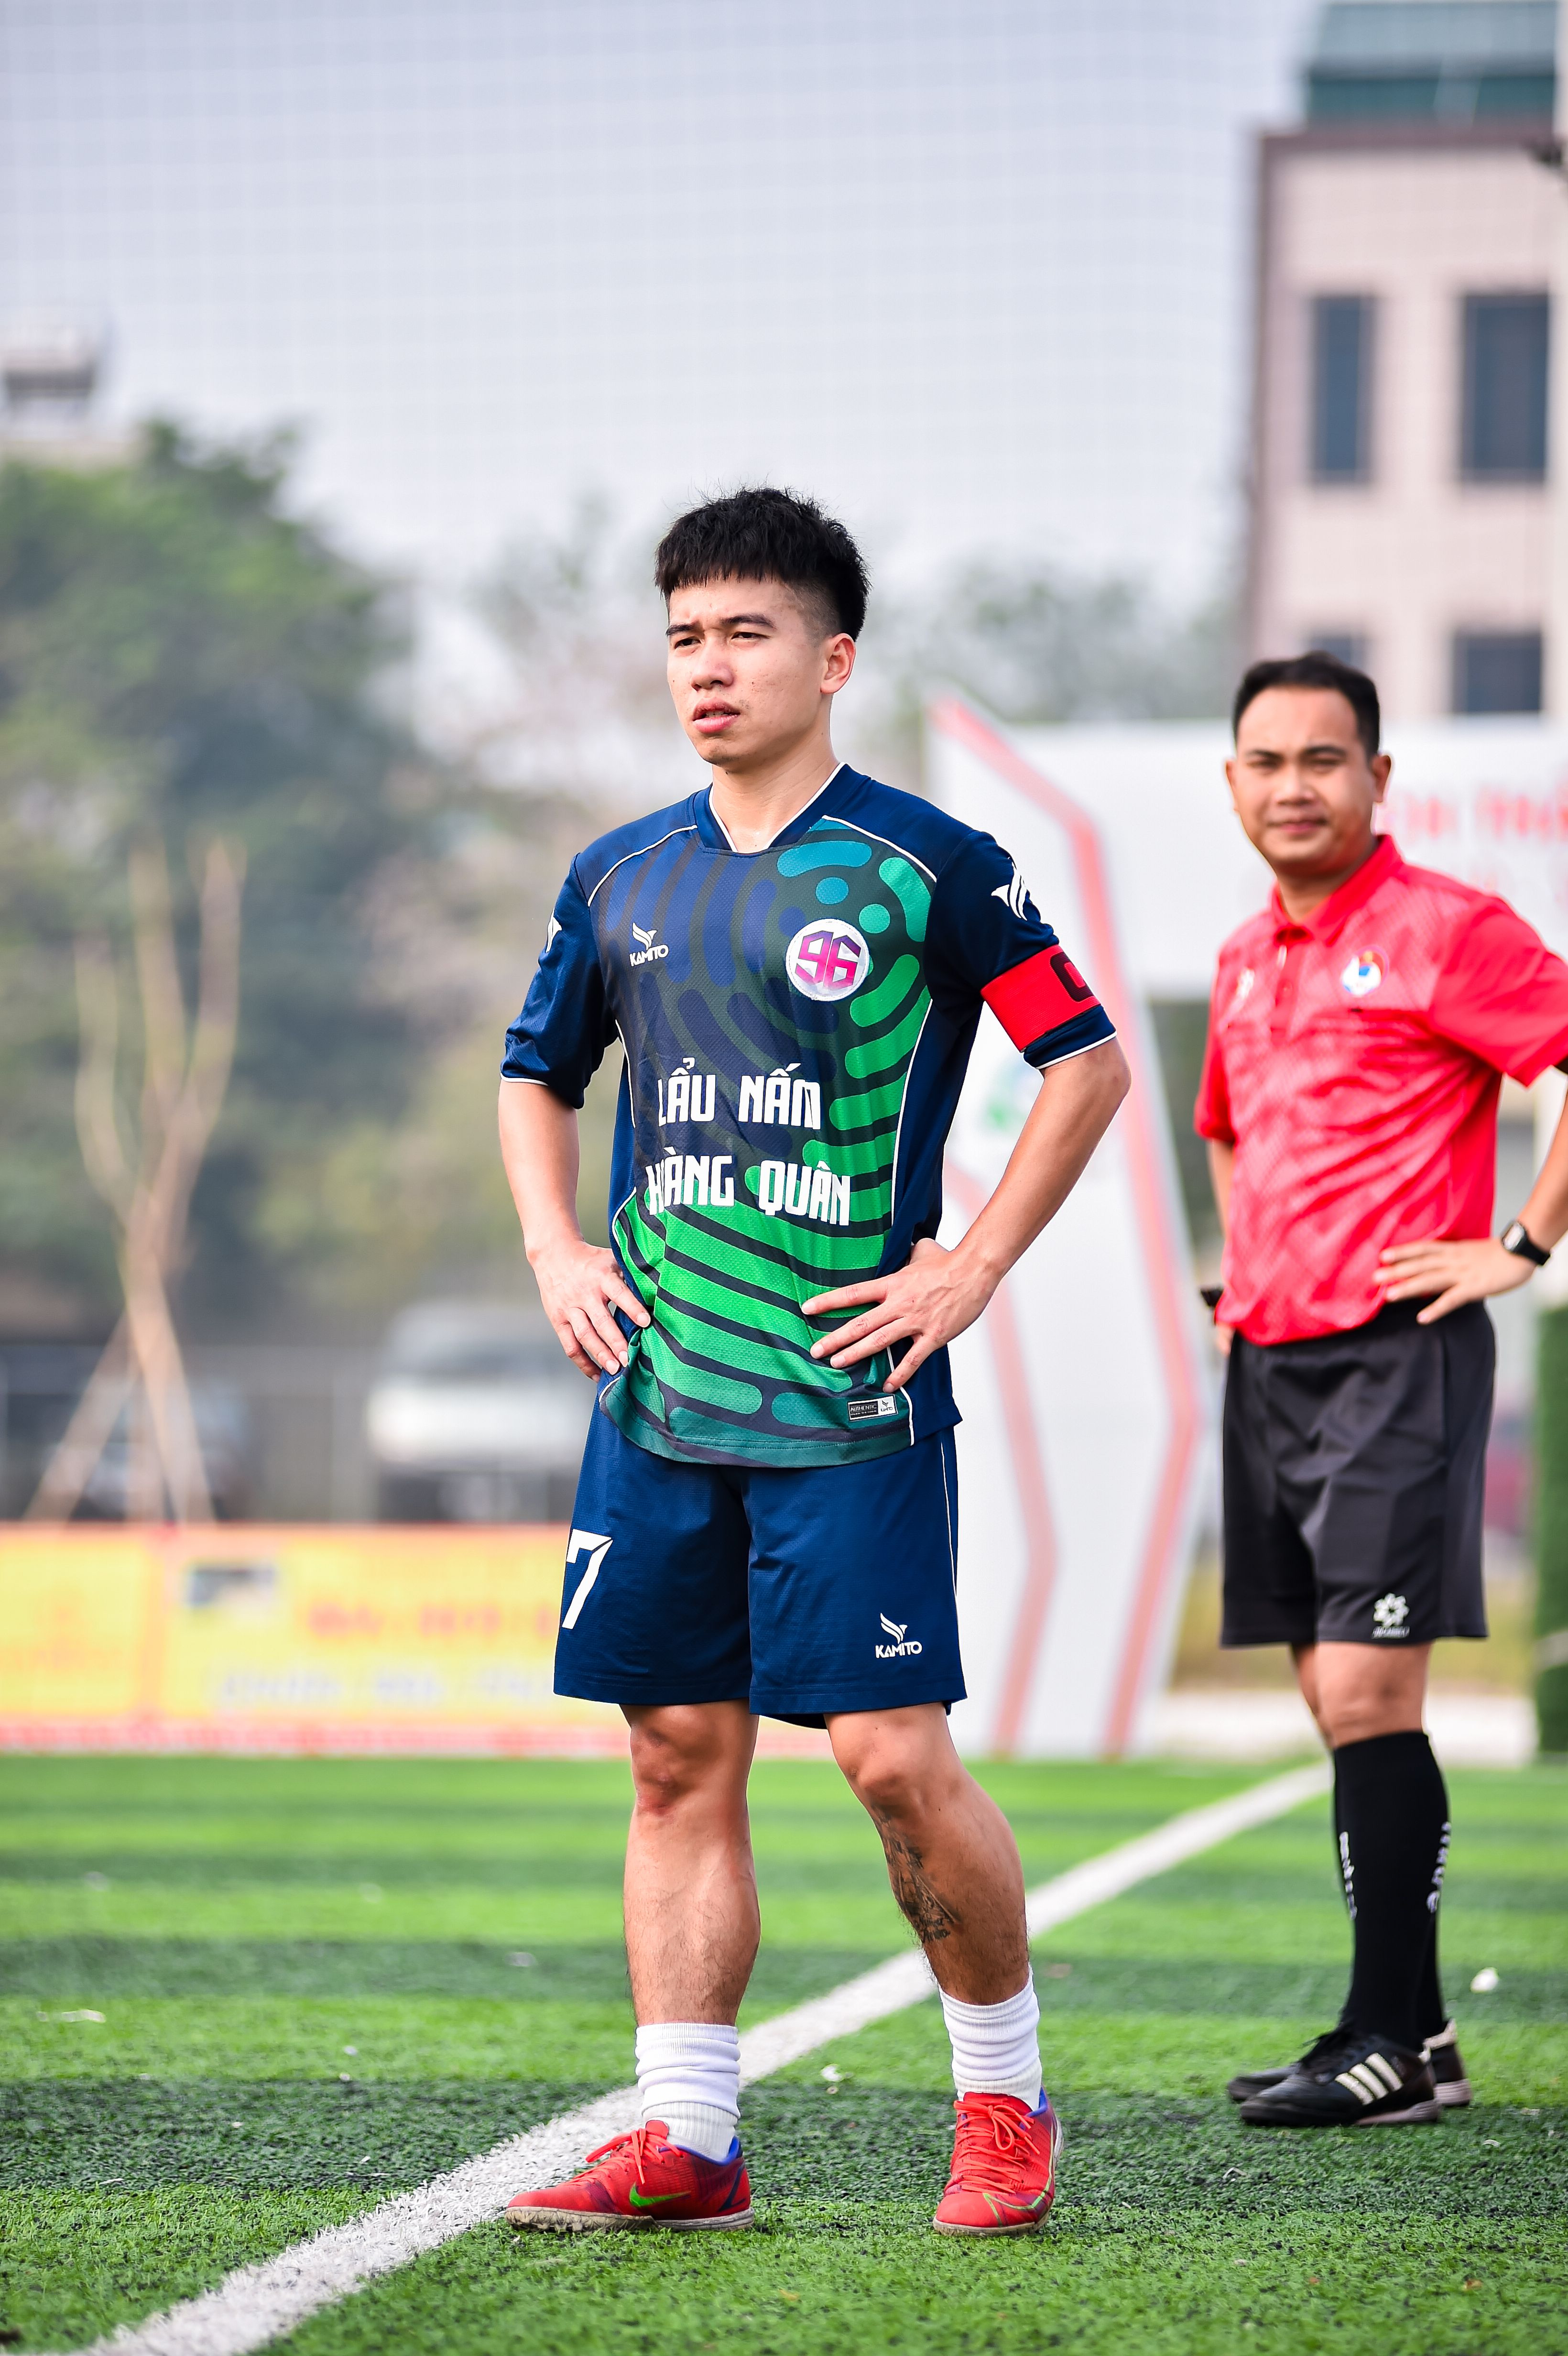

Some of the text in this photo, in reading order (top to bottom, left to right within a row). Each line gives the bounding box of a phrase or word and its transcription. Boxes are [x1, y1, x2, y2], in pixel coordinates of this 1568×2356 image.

[629, 944, 669, 967] KAMITO
[795, 930, 861, 991] 96
[658, 1057, 716, 1127] LẨU
[645, 1146, 851, 1226] HÀNG QUÂN
[562, 1528, 613, 1630] 7
[875, 1641, 923, 1658] KAMITO
